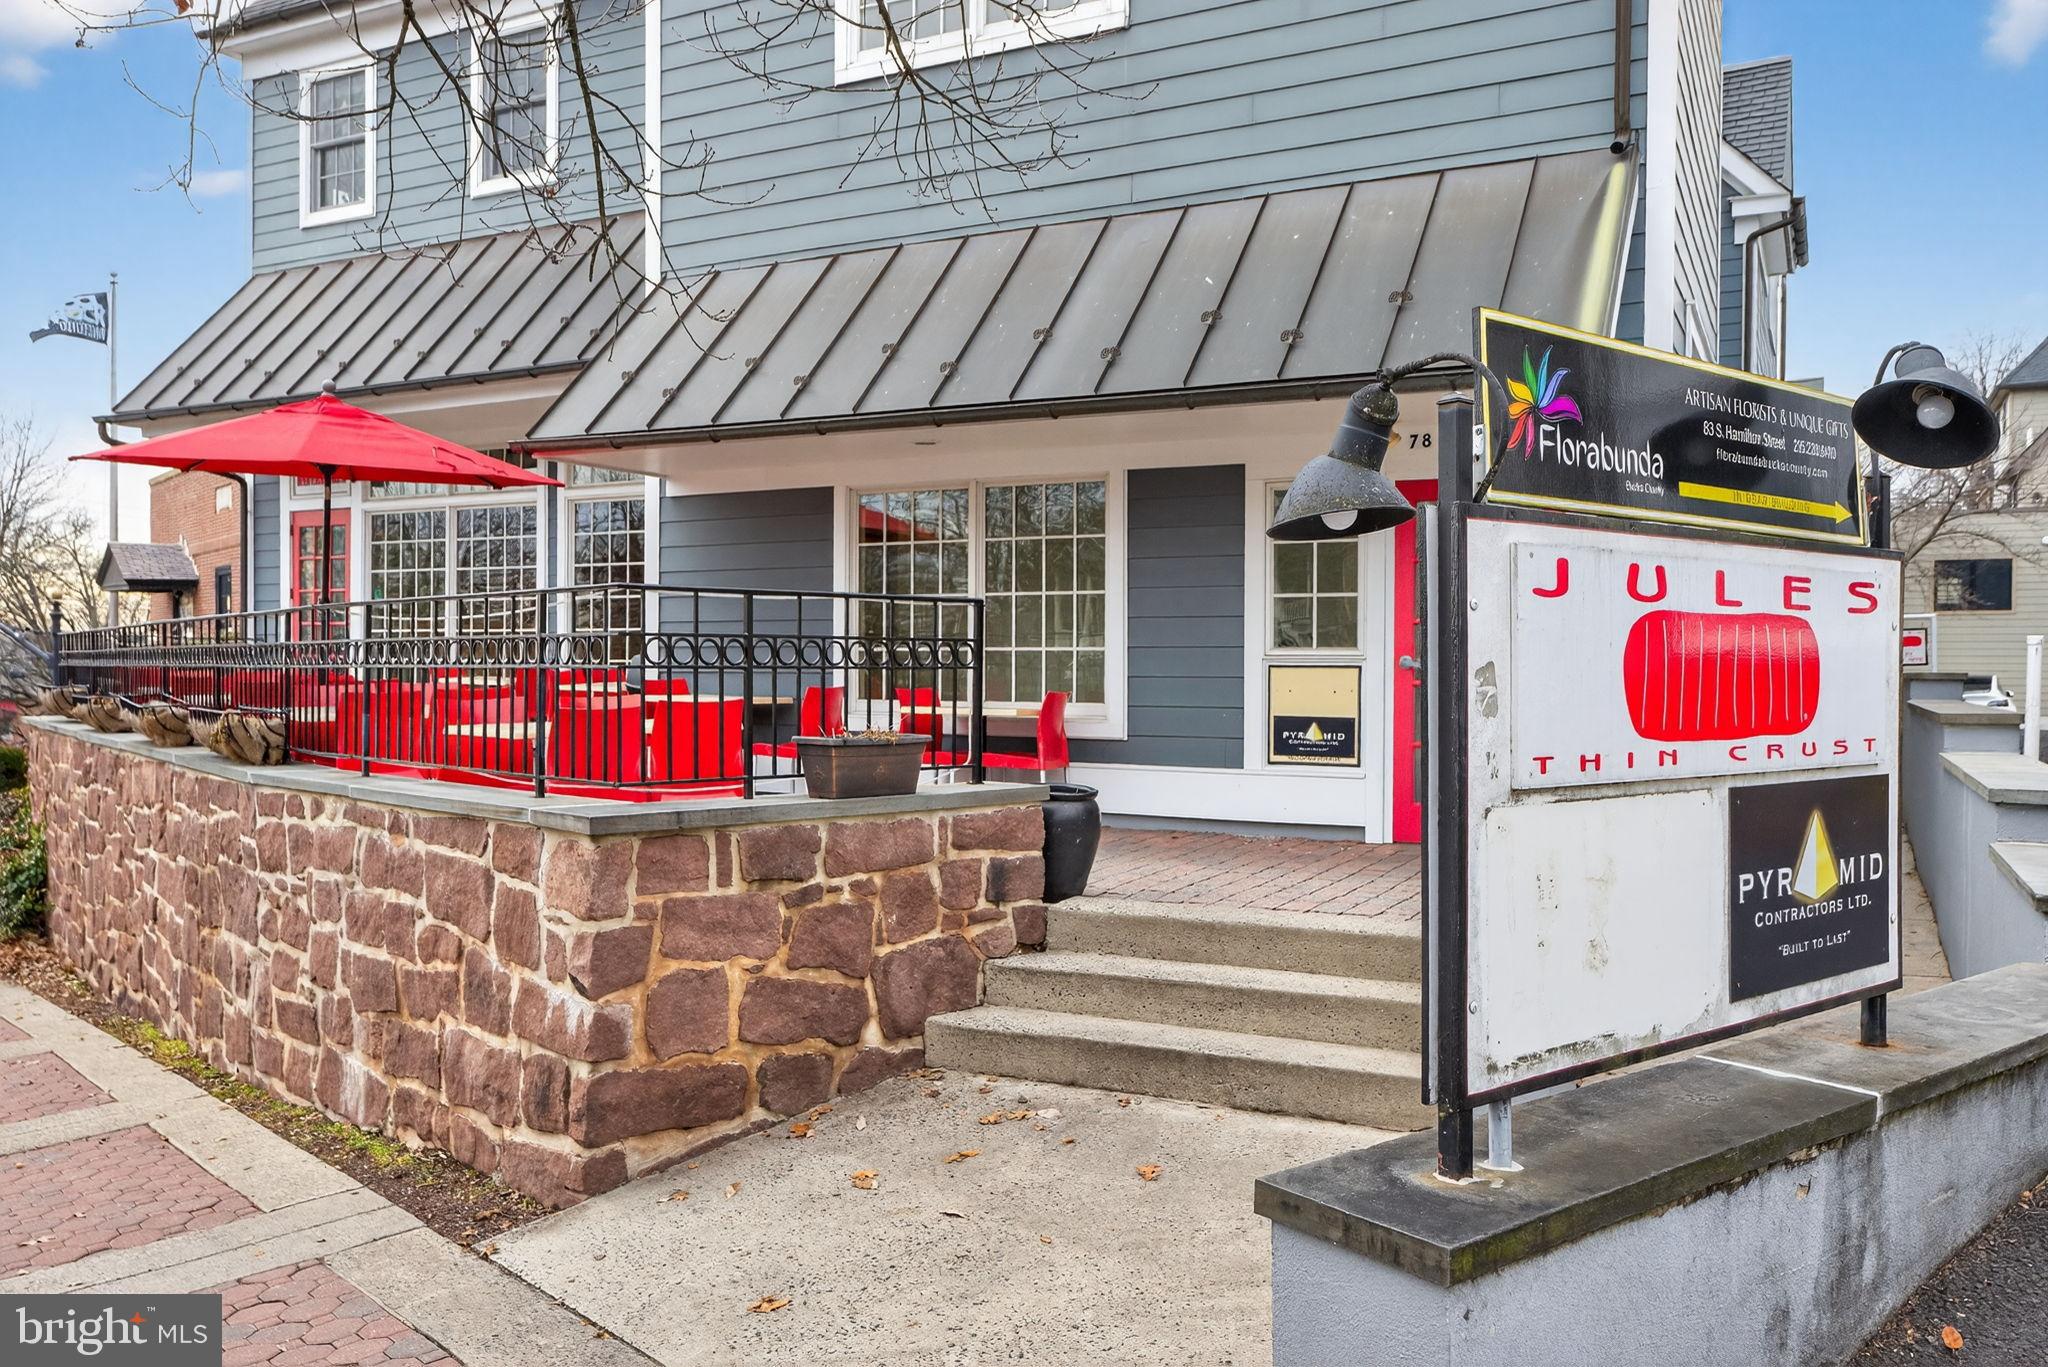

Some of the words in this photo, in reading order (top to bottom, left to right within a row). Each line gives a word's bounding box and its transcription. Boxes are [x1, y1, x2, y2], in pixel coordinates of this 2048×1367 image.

[1685, 387, 1732, 414] ARTISAN
[1734, 398, 1777, 423] FLORISTS
[1780, 409, 1787, 426] &
[1789, 411, 1824, 434] UNIQUE
[1826, 419, 1849, 440] GIFTS
[1409, 433, 1432, 449] 78
[1540, 423, 1664, 480] Florabunda
[1715, 422, 1725, 439] S.
[1726, 425, 1761, 445] Hamilton
[1762, 432, 1786, 450] Street
[1532, 557, 1879, 615] JULES
[1532, 749, 1678, 775] THIN
[1729, 737, 1878, 761] CRUST
[1754, 898, 1843, 928] CONTRACTORS
[1847, 894, 1872, 910] LTD.
[1812, 938, 1824, 949] TO
